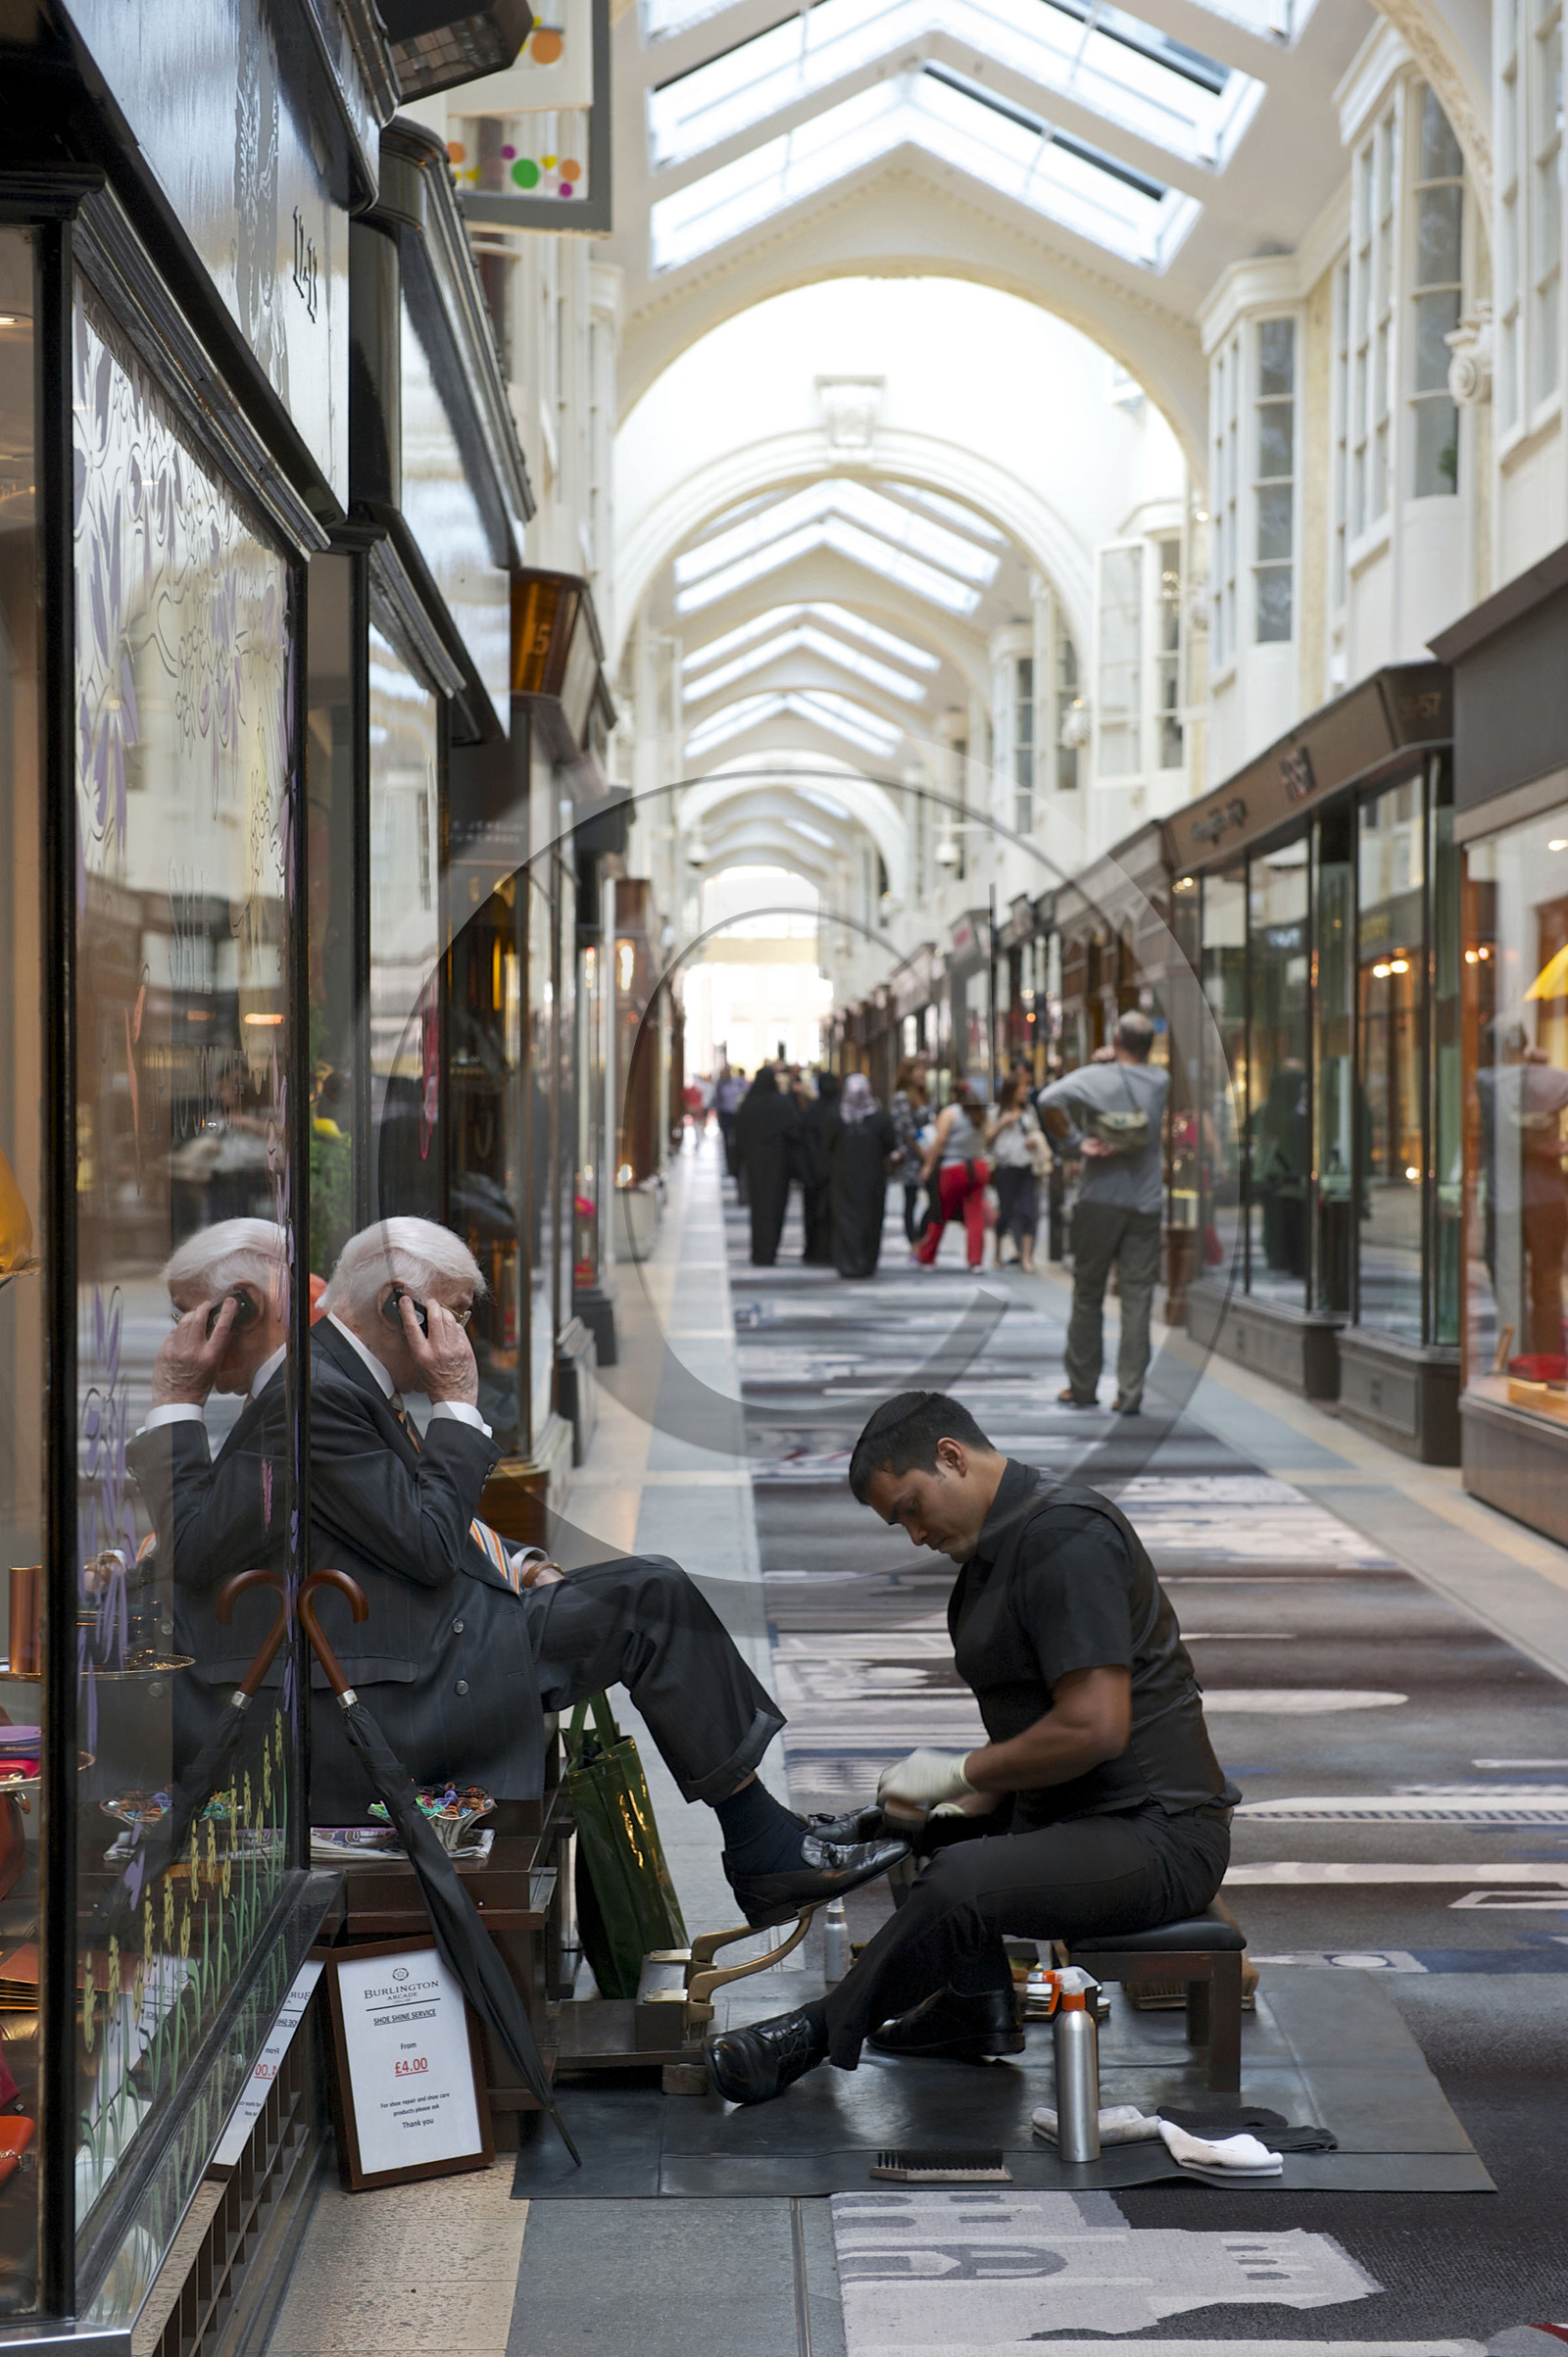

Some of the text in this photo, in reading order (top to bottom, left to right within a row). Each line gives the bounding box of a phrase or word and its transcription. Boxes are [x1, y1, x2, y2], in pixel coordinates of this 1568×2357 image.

[168, 856, 213, 995] SALE
[364, 1980, 439, 1999] BURLINGTON
[386, 1991, 418, 2001] ARCADE
[373, 2008, 436, 2025] SHOE SHINE SERVICE
[395, 2057, 428, 2075] £4.00
[392, 2108, 416, 2118] products
[415, 2105, 431, 2114] please
[402, 2118, 435, 2129] Thank you
